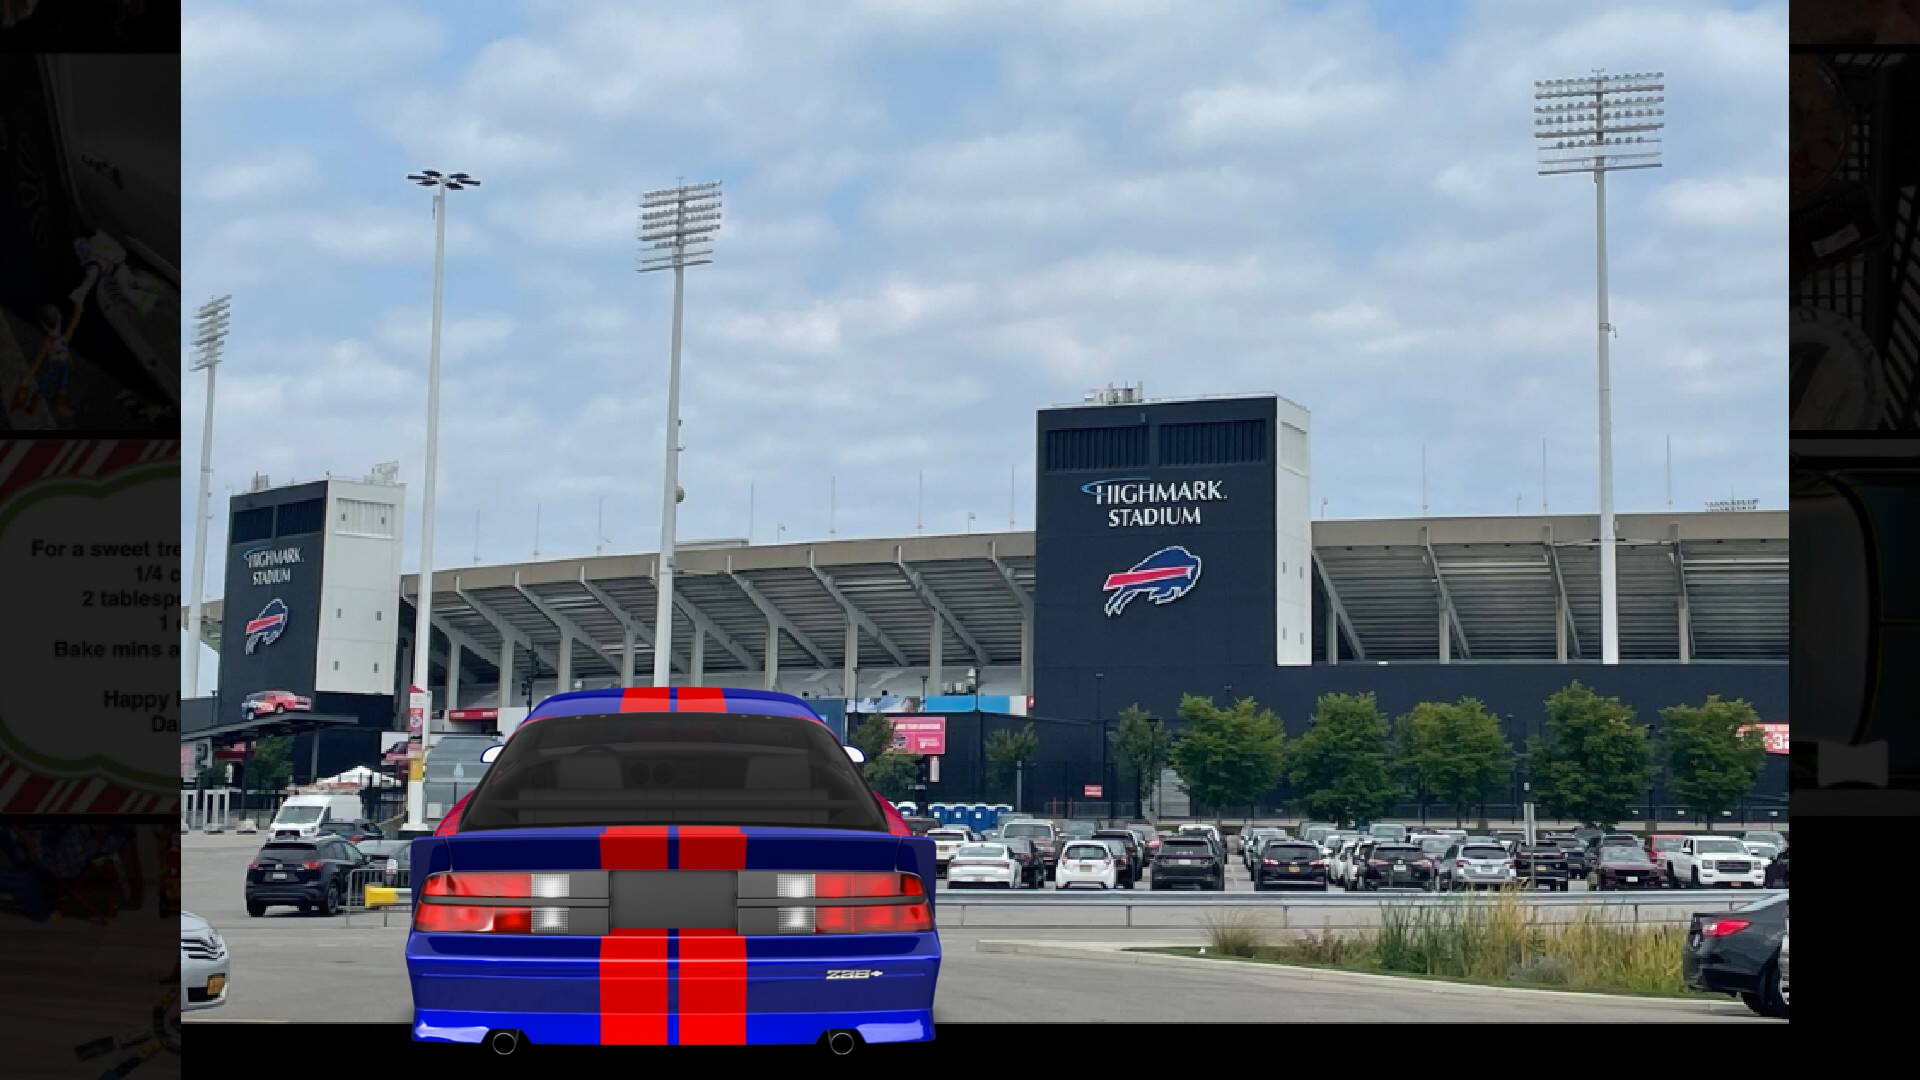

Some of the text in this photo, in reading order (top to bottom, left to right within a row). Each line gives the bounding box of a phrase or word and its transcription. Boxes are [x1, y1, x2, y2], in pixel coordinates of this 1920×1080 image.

[1108, 506, 1201, 527] STADIUM
[31, 539, 66, 557] For
[72, 544, 84, 557] a
[90, 541, 150, 557] sweet
[135, 565, 163, 582] 1/4
[81, 590, 94, 607] 2
[160, 614, 167, 632] 1
[54, 641, 106, 658] Bake
[112, 641, 163, 658] mins
[103, 690, 170, 712] Happy
